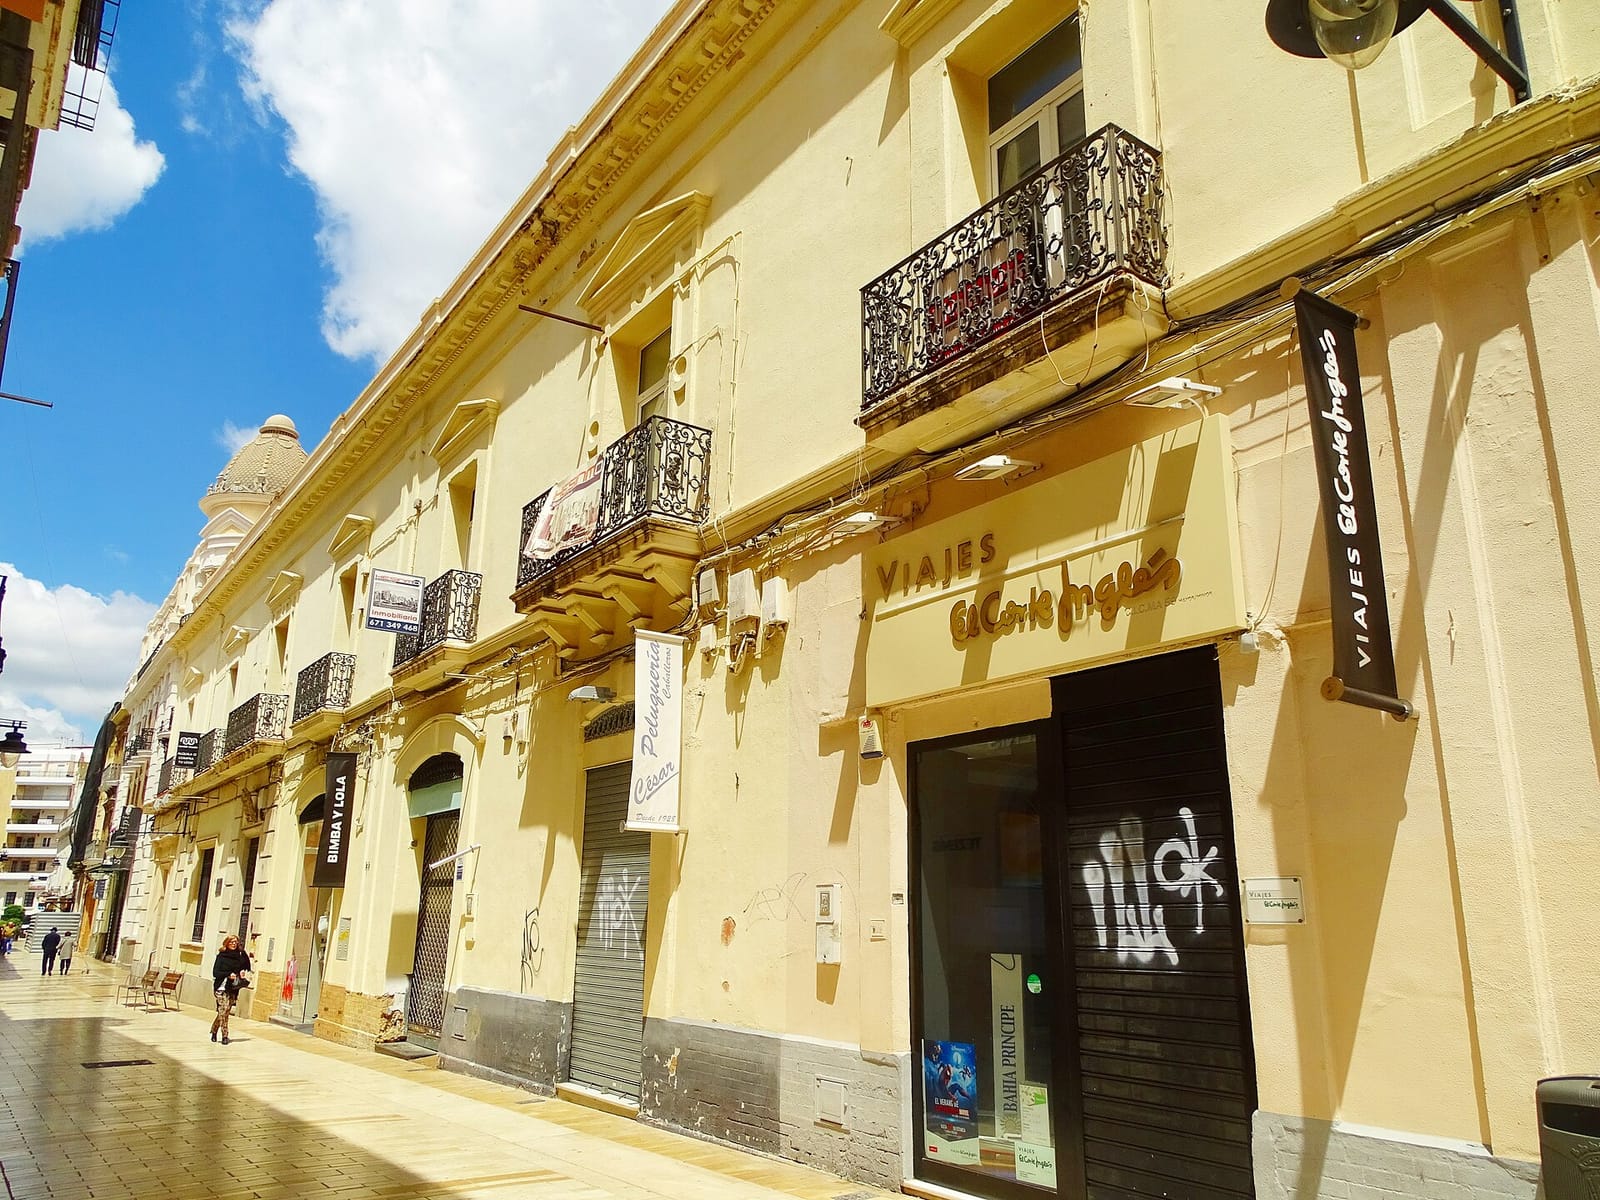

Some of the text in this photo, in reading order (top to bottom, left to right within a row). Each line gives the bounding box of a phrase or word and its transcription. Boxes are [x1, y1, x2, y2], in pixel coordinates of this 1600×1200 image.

[1332, 431, 1355, 504] Corte
[1337, 505, 1358, 535] El
[876, 533, 996, 602] VIAJES
[369, 619, 418, 632] 671 349 468
[950, 599, 980, 642] El
[979, 587, 1053, 634] Corte
[1346, 548, 1372, 668] VIAJES
[634, 761, 675, 805] César
[327, 775, 346, 863] BIMBA Y LOLA
[1000, 1005, 1018, 1113] BAHIA PRINCIPE
